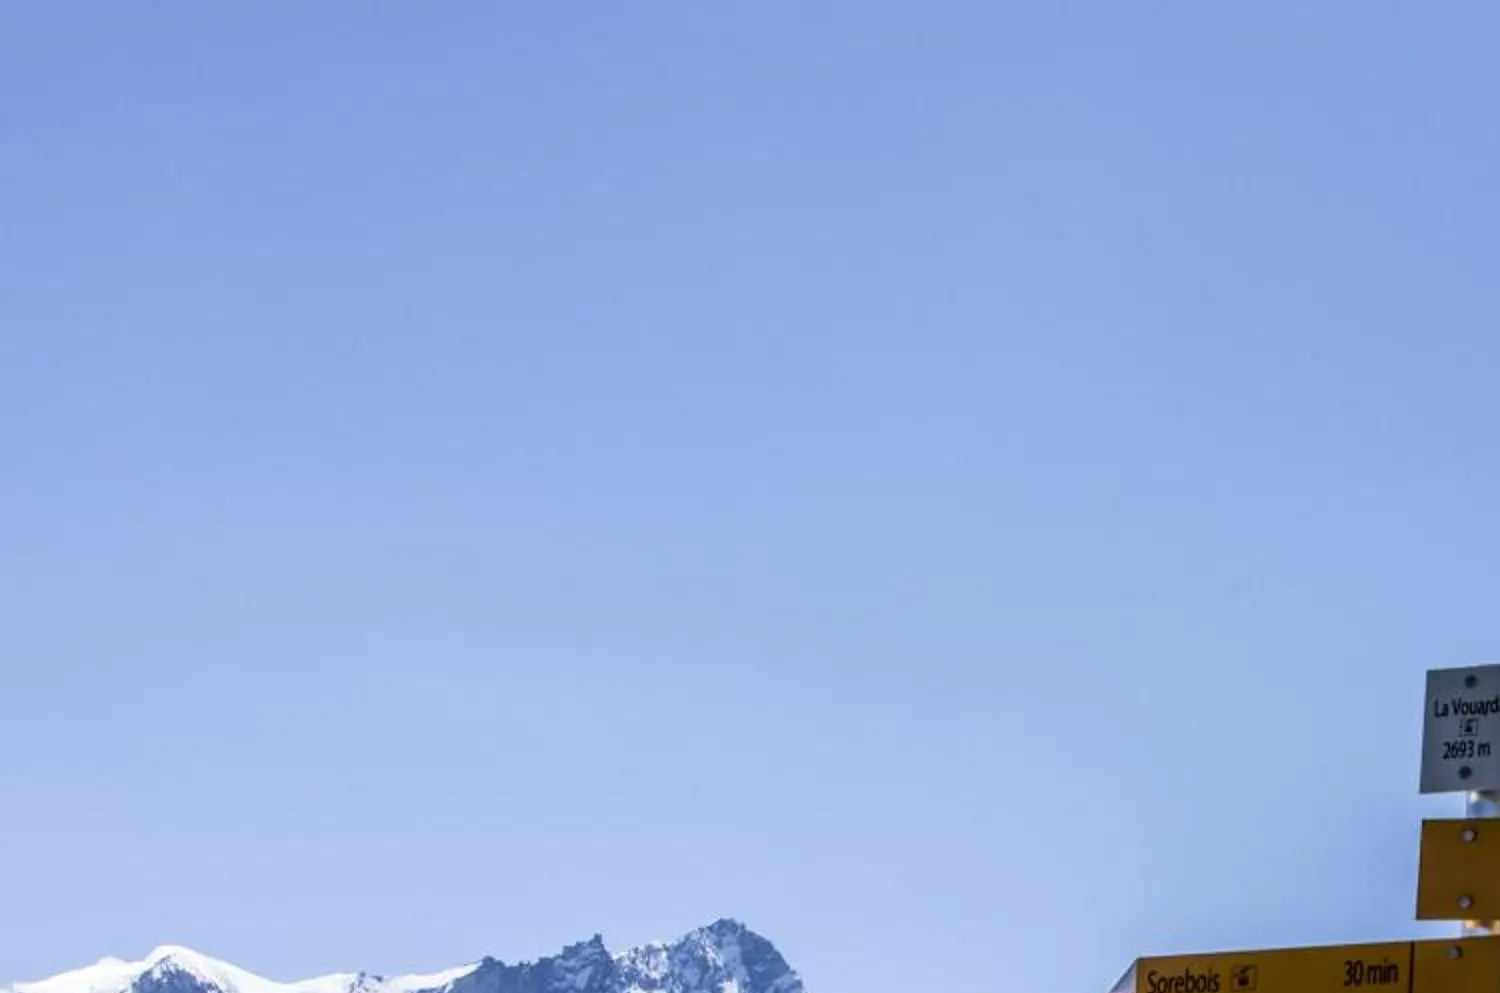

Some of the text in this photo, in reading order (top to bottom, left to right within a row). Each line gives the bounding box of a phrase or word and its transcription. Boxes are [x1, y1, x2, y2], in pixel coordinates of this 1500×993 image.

[1434, 698, 1449, 718] La
[1442, 740, 1491, 760] 2693 m
[1343, 960, 1364, 987] 30
[1367, 958, 1399, 985] min
